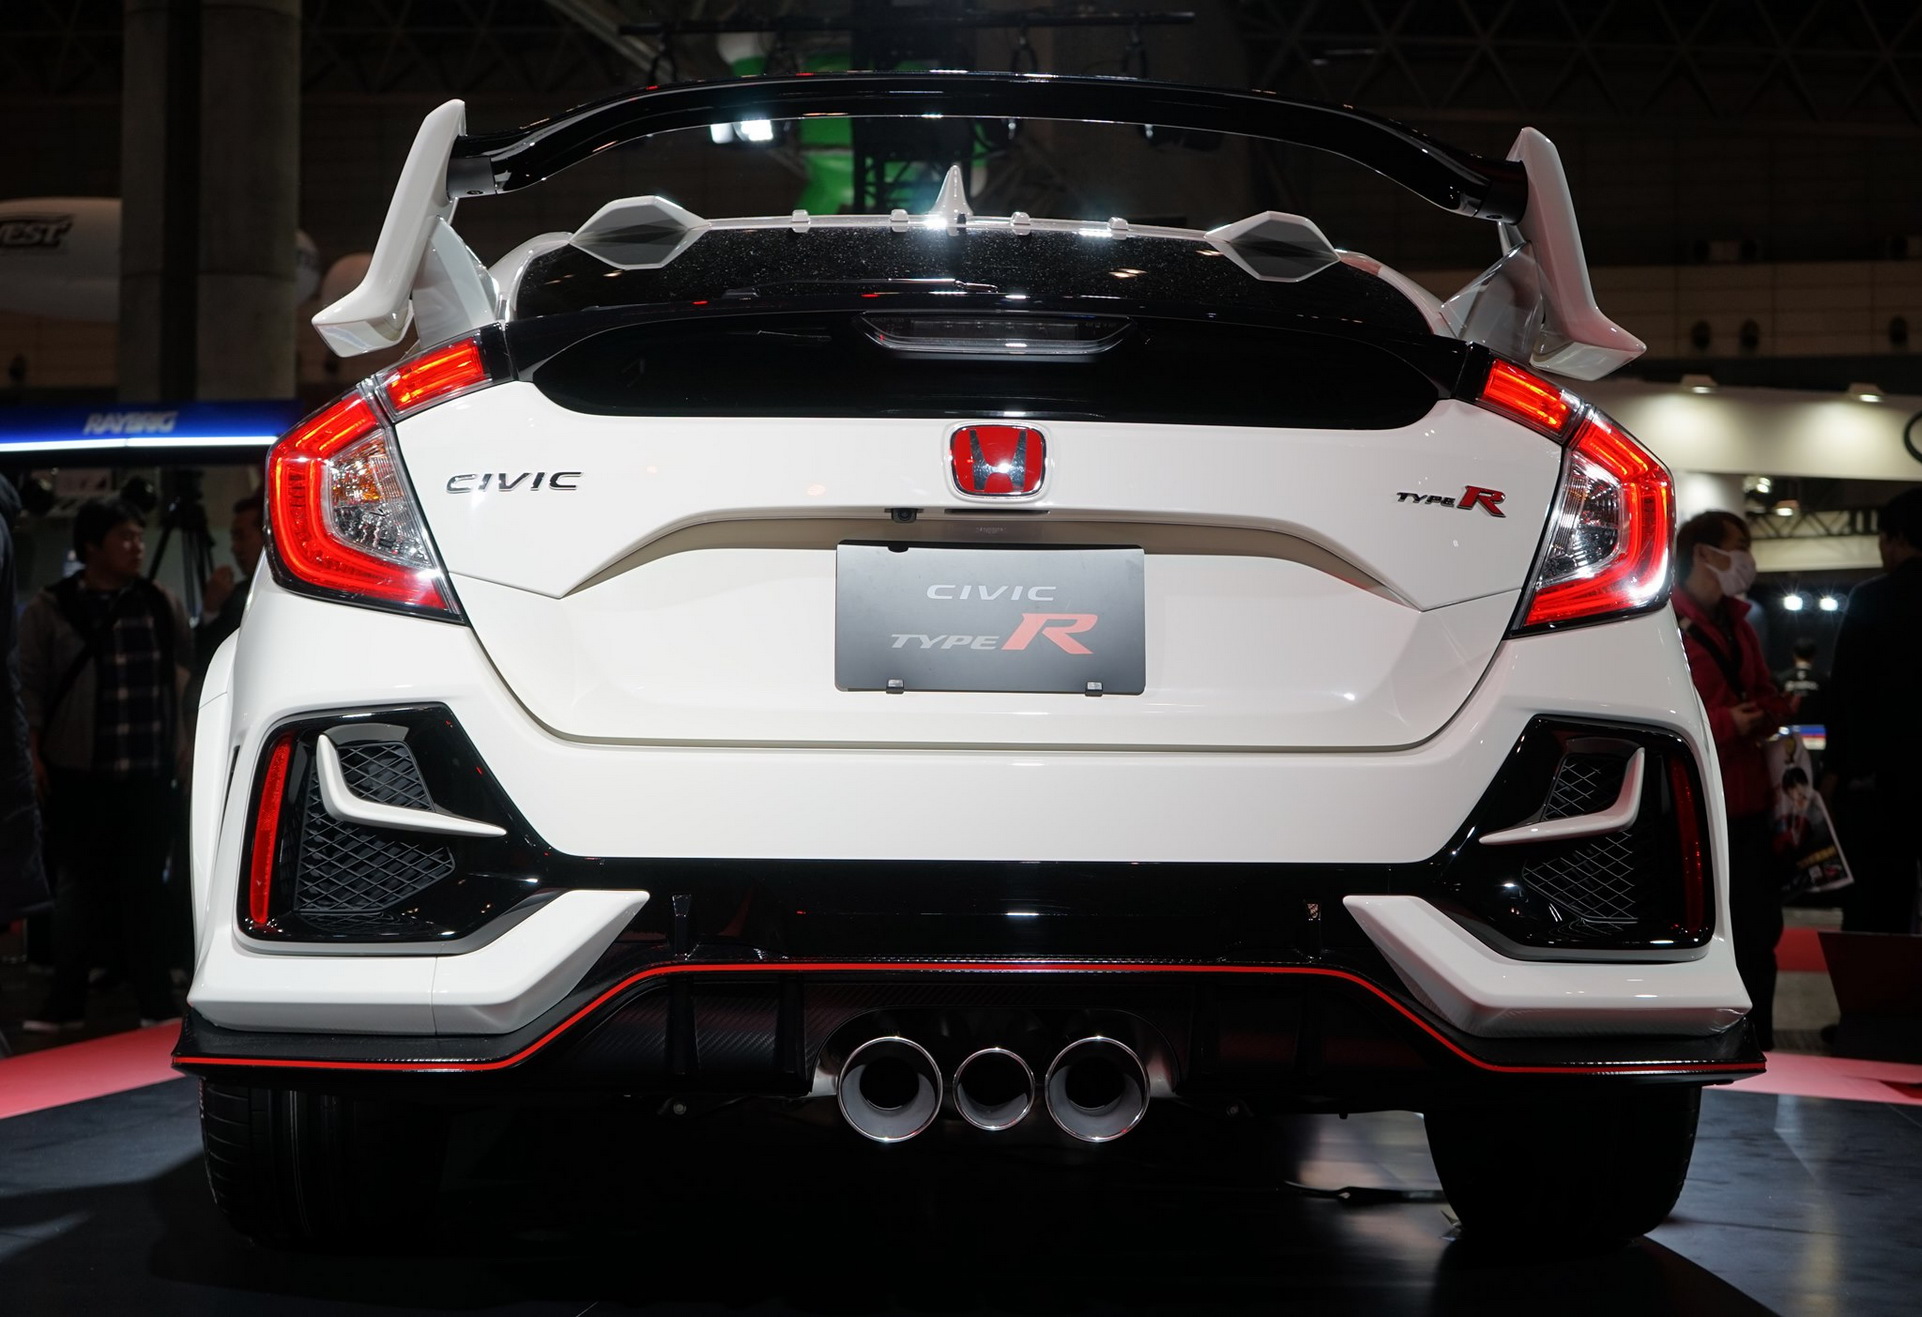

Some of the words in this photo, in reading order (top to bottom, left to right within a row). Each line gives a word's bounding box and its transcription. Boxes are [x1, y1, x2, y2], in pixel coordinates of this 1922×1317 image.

[446, 472, 583, 494] CIVIC
[1396, 492, 1456, 508] TYPE
[1457, 485, 1506, 518] R
[926, 584, 1057, 601] CIVIC
[891, 633, 1000, 650] TYPE
[1001, 613, 1099, 655] R
